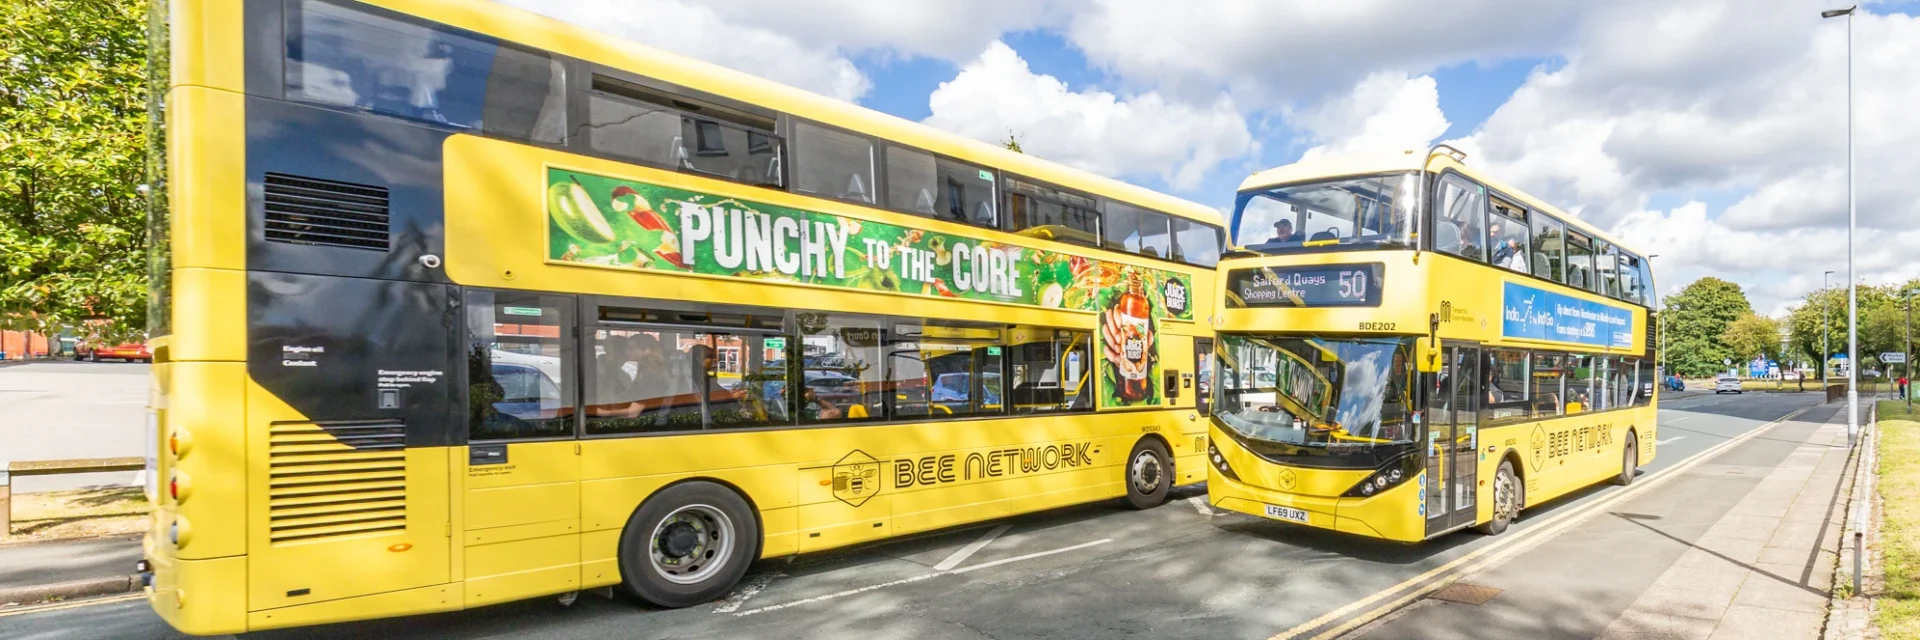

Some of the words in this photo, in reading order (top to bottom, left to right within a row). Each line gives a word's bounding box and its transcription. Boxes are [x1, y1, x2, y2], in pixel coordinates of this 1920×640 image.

[679, 201, 849, 280] PUNCHY
[863, 237, 890, 270] TO
[900, 246, 937, 284] THE
[951, 242, 1023, 298] CORE
[1253, 272, 1291, 287] Salford
[1293, 272, 1326, 287] Quays
[1338, 270, 1366, 298] 50
[1165, 282, 1186, 300] JUICE
[1244, 288, 1276, 300] Shopping
[1277, 288, 1306, 299] Centre
[1166, 298, 1185, 310] BURST
[1359, 321, 1396, 332] BDE202
[378, 369, 418, 378] Emergency
[1548, 430, 1569, 459] BEE
[1570, 422, 1614, 454] NETWORK
[894, 453, 956, 489] BEE
[964, 441, 1092, 482] NETWORK
[1267, 506, 1288, 518] LF69
[1288, 510, 1306, 521] UXZ
